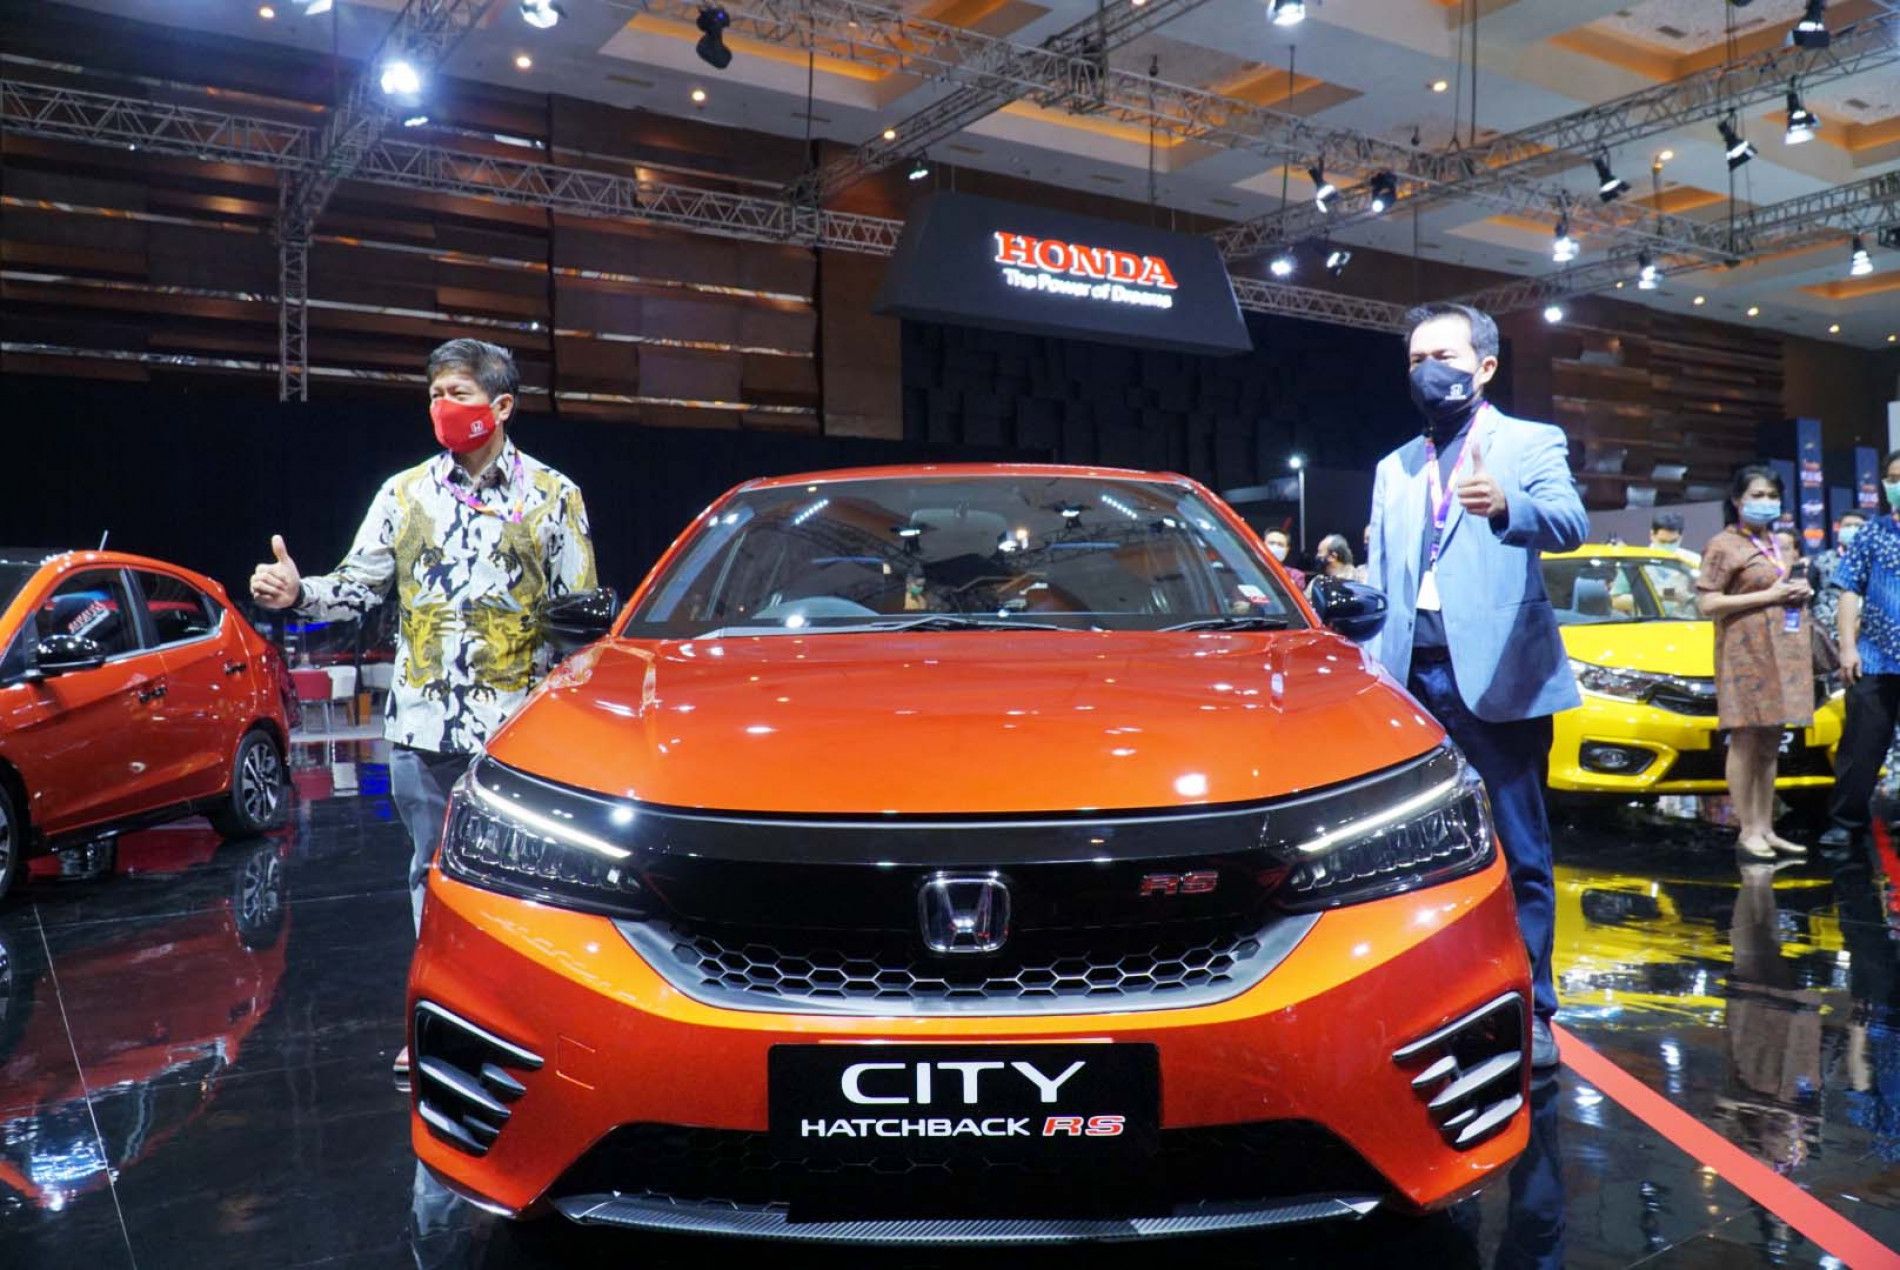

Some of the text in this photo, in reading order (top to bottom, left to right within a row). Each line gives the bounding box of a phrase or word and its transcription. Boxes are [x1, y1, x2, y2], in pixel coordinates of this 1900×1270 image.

[994, 230, 1178, 289] HONDA
[1002, 268, 1037, 290] The
[1091, 283, 1111, 300] of
[1140, 872, 1218, 896] RS
[841, 1061, 1086, 1104] CITY
[801, 1115, 1126, 1137] HATCHBACK RS
